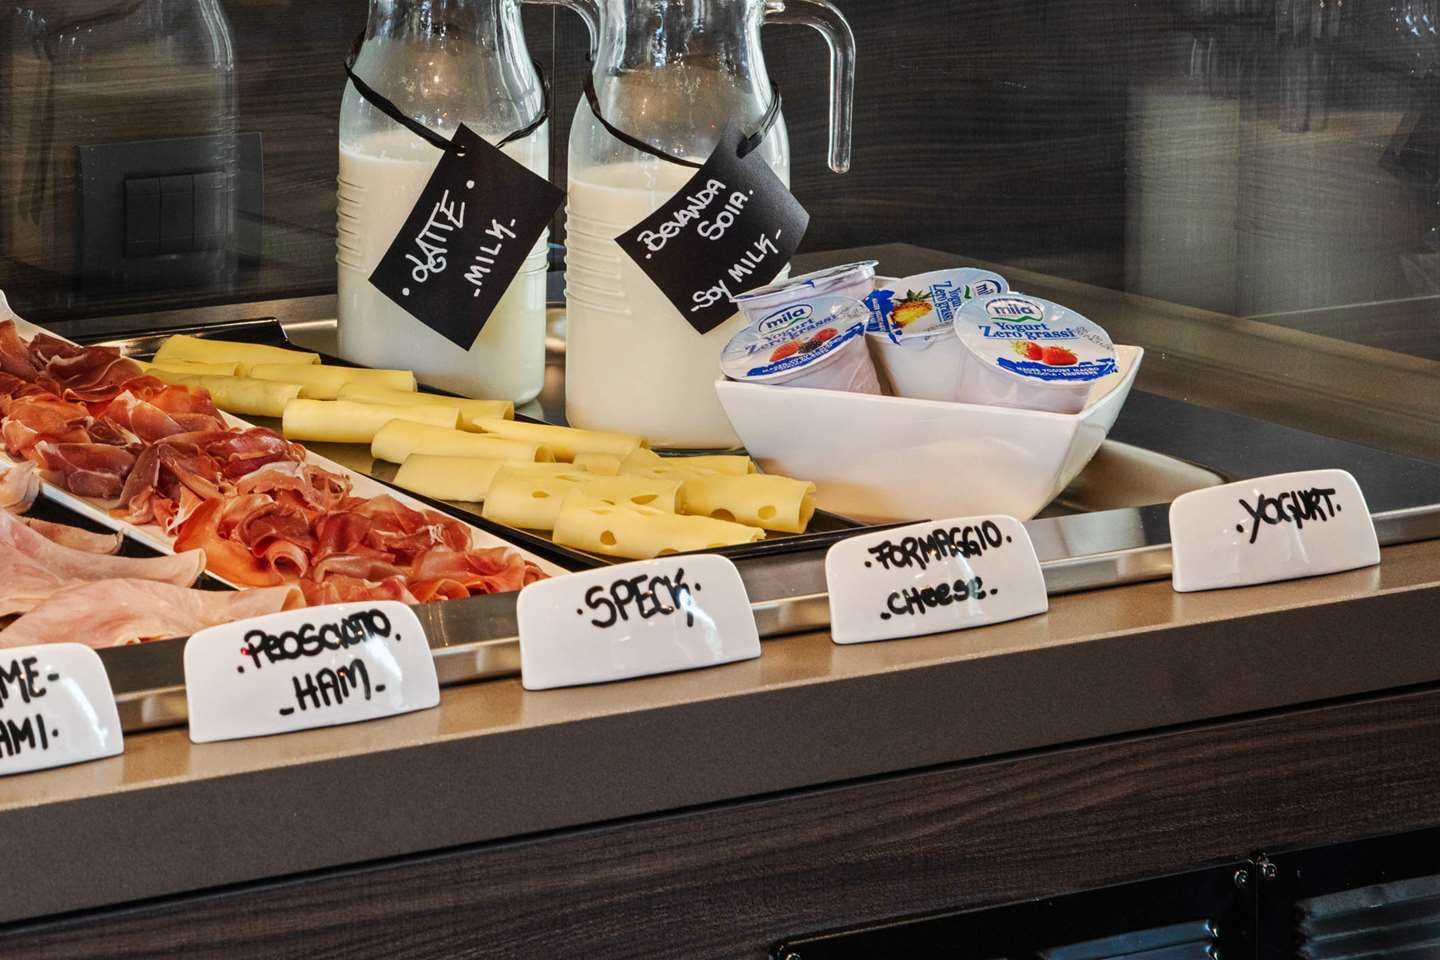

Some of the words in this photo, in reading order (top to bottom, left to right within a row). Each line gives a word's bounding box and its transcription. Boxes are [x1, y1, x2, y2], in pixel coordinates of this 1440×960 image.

[992, 303, 1035, 316] mila
[765, 307, 807, 330] mila
[978, 325, 1023, 339] Zero
[1025, 326, 1076, 341] grassi
[993, 321, 1050, 334] Yogurt
